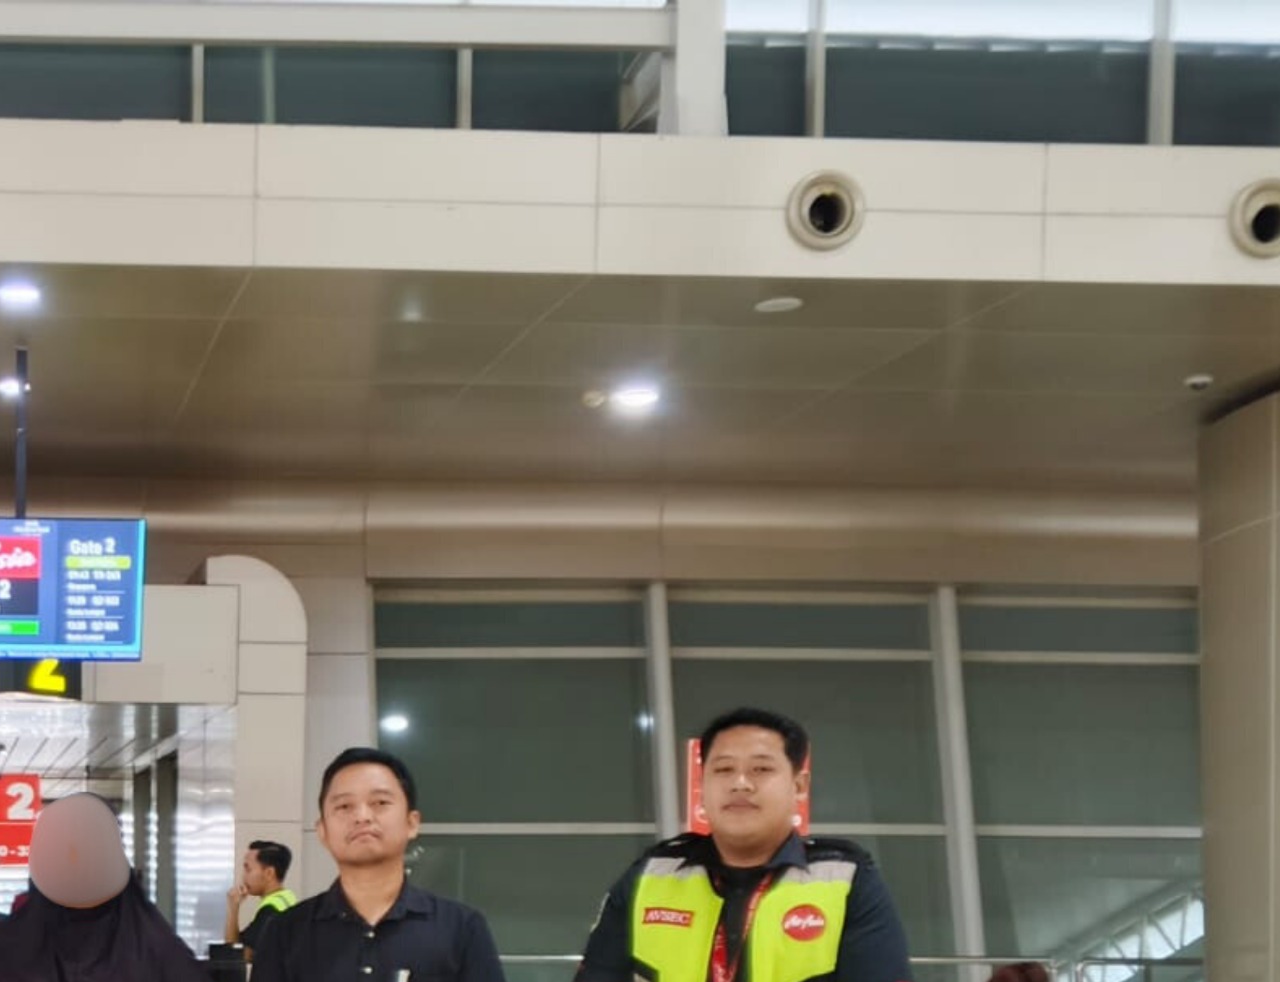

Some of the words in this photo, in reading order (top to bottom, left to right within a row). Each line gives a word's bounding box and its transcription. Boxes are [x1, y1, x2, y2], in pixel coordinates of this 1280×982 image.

[69, 538, 103, 555] Gate
[104, 536, 116, 553] 2
[6, 782, 35, 820] 2
